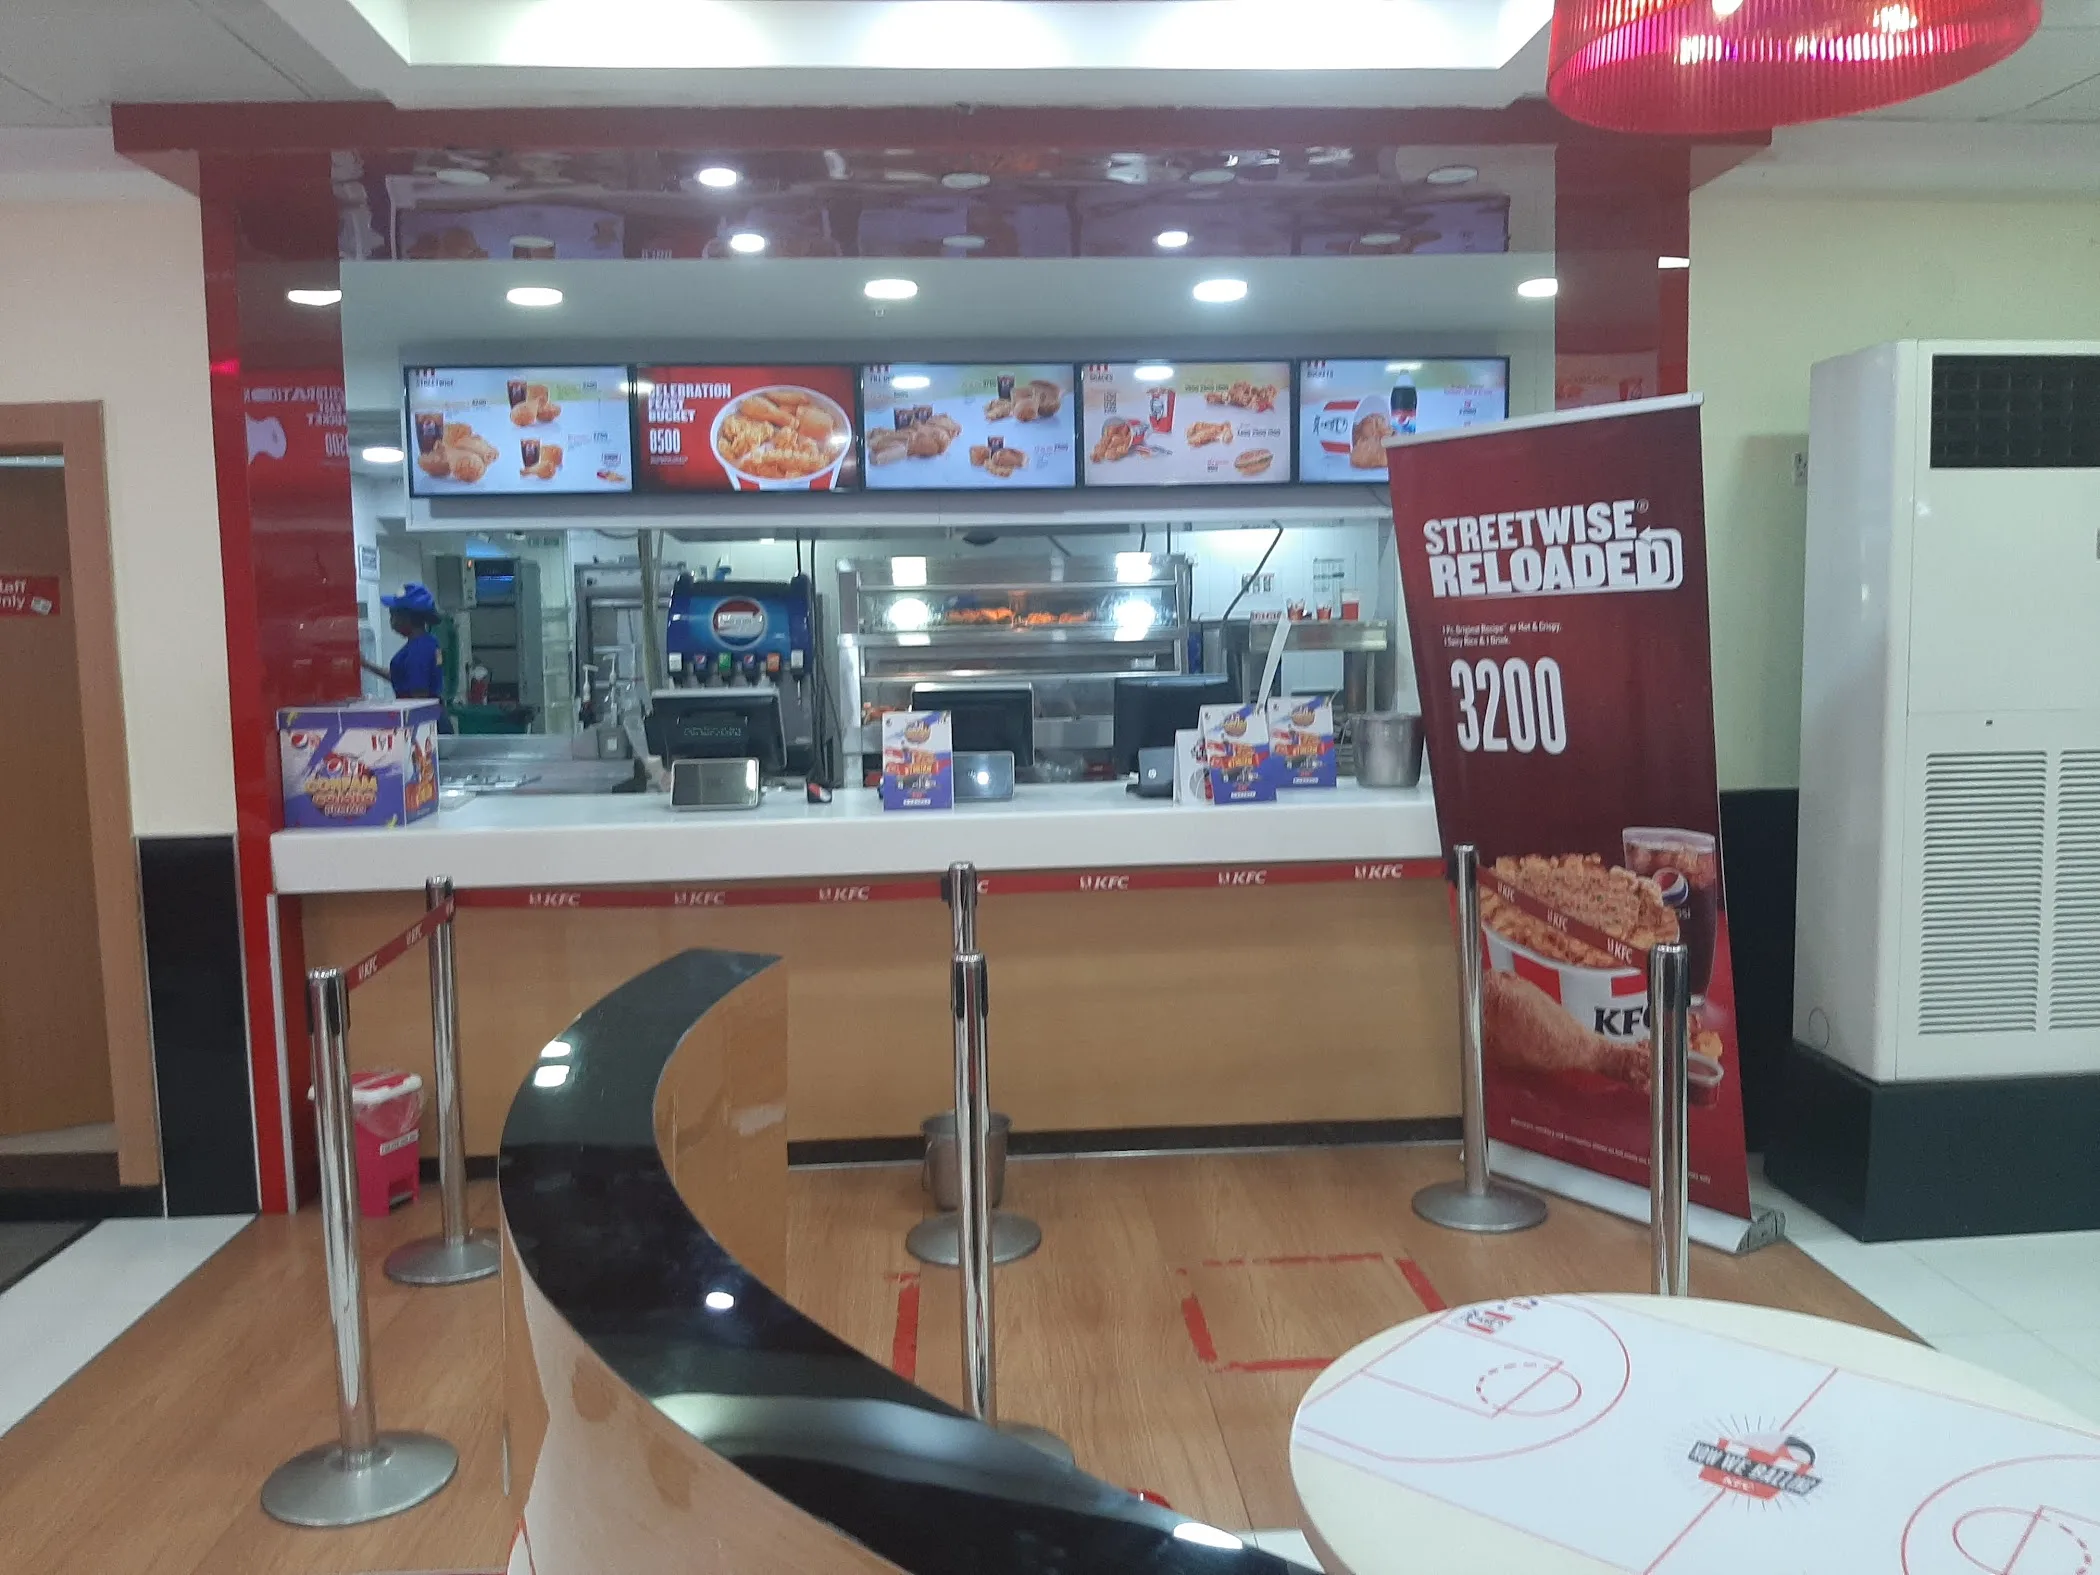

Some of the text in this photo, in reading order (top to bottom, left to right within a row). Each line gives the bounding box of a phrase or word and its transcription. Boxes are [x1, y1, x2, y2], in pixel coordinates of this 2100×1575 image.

[1428, 534, 1677, 598] RELOADED
[1450, 656, 1567, 755] 3200
[1231, 870, 1267, 885] KFC
[1368, 864, 1403, 880] KFC
[1093, 875, 1130, 890] KFC
[543, 892, 581, 907] KFC
[689, 891, 726, 905] KFC
[833, 886, 870, 901] KFC
[1594, 1005, 1651, 1037] KF
